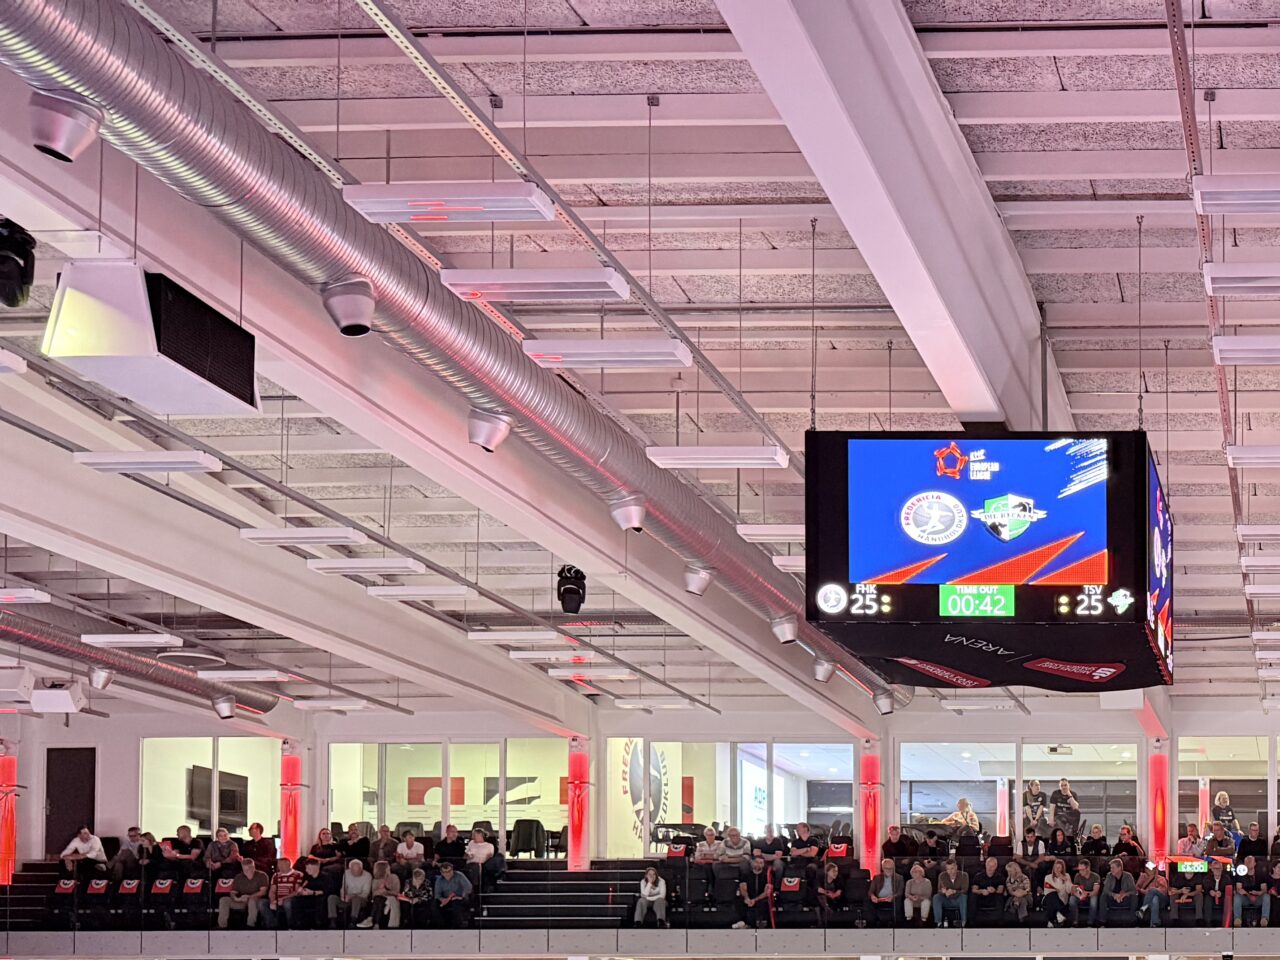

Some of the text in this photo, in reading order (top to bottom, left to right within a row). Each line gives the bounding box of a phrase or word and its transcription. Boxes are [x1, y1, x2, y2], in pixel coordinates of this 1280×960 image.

[903, 493, 942, 526] FREDERICIA
[855, 584, 877, 594] FHK
[955, 585, 999, 594] TIME OUT
[1083, 584, 1102, 594] TSV
[850, 595, 877, 615] 25
[947, 595, 1007, 615] 00:42
[1076, 595, 1103, 615] 25
[945, 633, 1015, 656] ARENA
